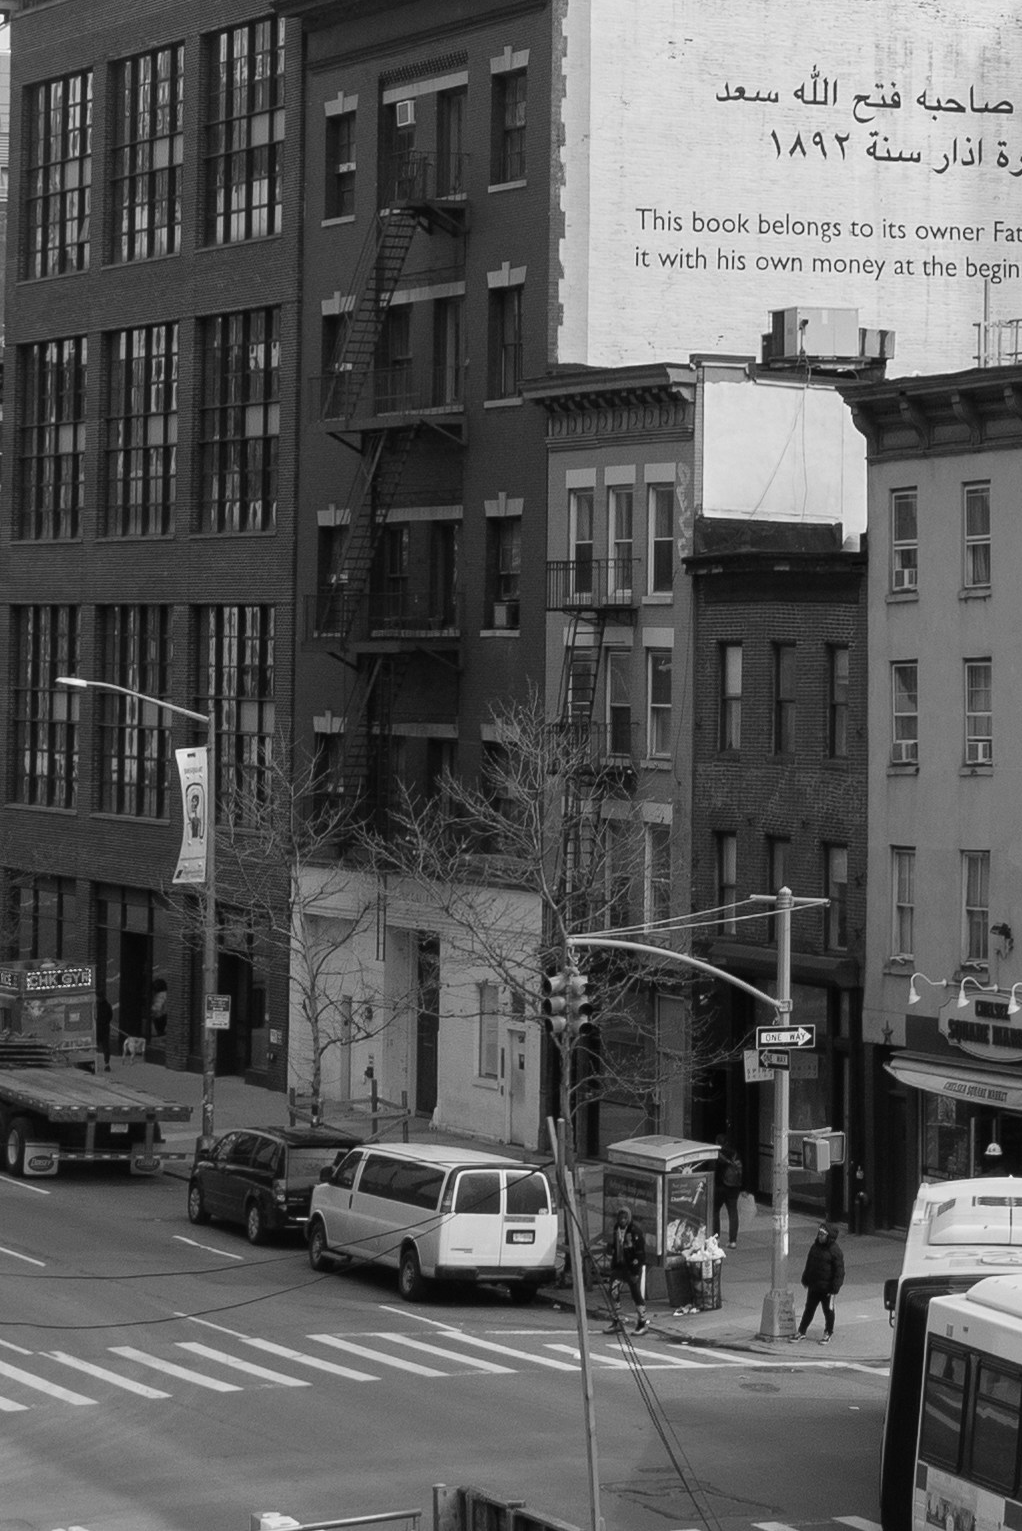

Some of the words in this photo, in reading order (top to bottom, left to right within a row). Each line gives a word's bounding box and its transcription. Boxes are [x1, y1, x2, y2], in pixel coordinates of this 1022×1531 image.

[716, 81, 779, 103] سعد
[852, 81, 901, 123] فتح
[916, 85, 1014, 121] صاحبه
[771, 129, 850, 160] ١٨٩٢
[866, 130, 921, 163] سنة
[932, 137, 983, 174] اذار
[635, 208, 683, 232] This
[692, 211, 750, 234] book
[758, 213, 841, 243] belongs
[850, 220, 873, 238] to
[882, 218, 906, 239] its
[915, 224, 985, 242] owner
[635, 247, 650, 268] it
[658, 248, 707, 269] with
[717, 248, 746, 270] his
[755, 256, 803, 272] own
[812, 257, 886, 280] money
[894, 258, 915, 276] at
[923, 255, 957, 277] the
[29, 974, 58, 987] CHK
[765, 1033, 783, 1042] ONE
[789, 1032, 807, 1041] WAY
[948, 1018, 990, 1045] SQUARE
